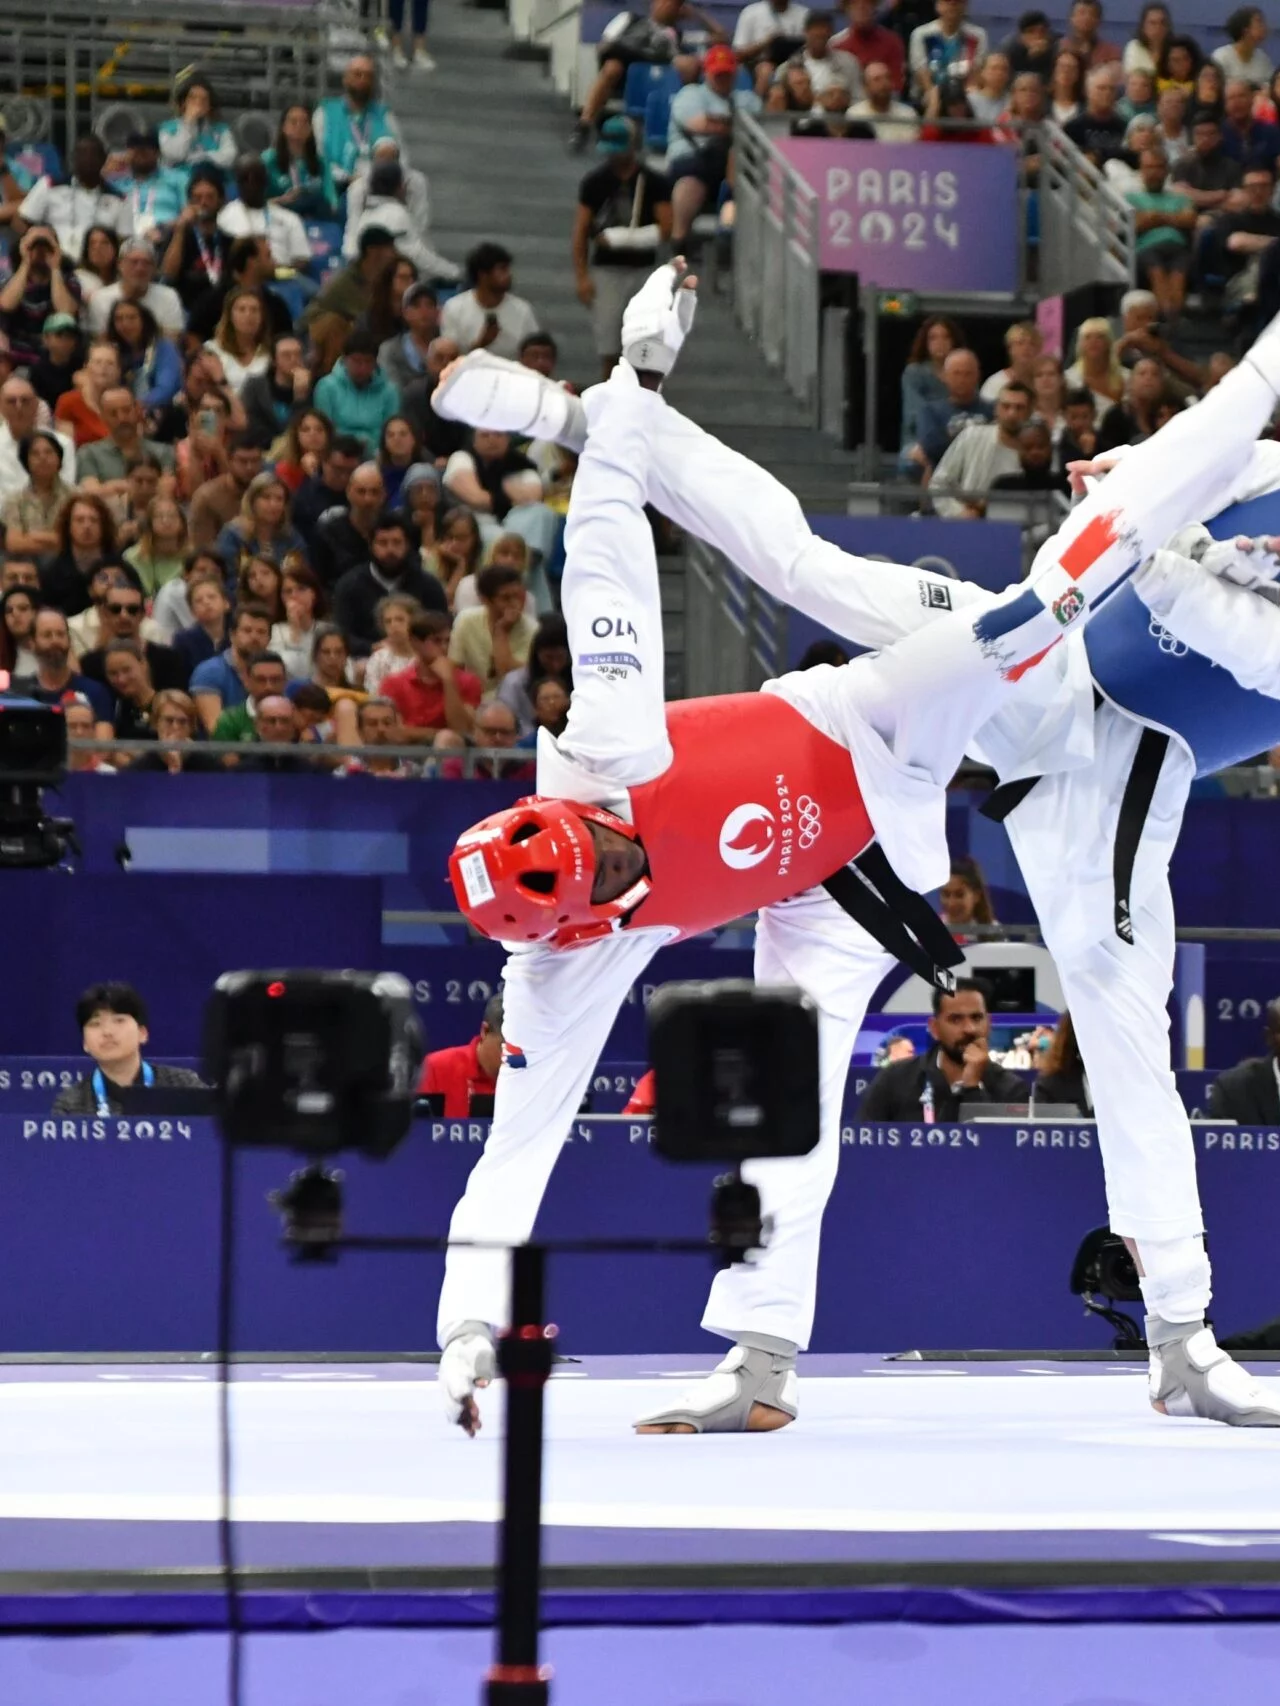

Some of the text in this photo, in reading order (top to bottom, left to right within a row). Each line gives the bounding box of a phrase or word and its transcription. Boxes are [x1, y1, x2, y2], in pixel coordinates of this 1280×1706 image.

[828, 209, 959, 249] 2024
[775, 774, 792, 823] 2024
[117, 1120, 191, 1141] 2024
[910, 1128, 980, 1147] 2024
